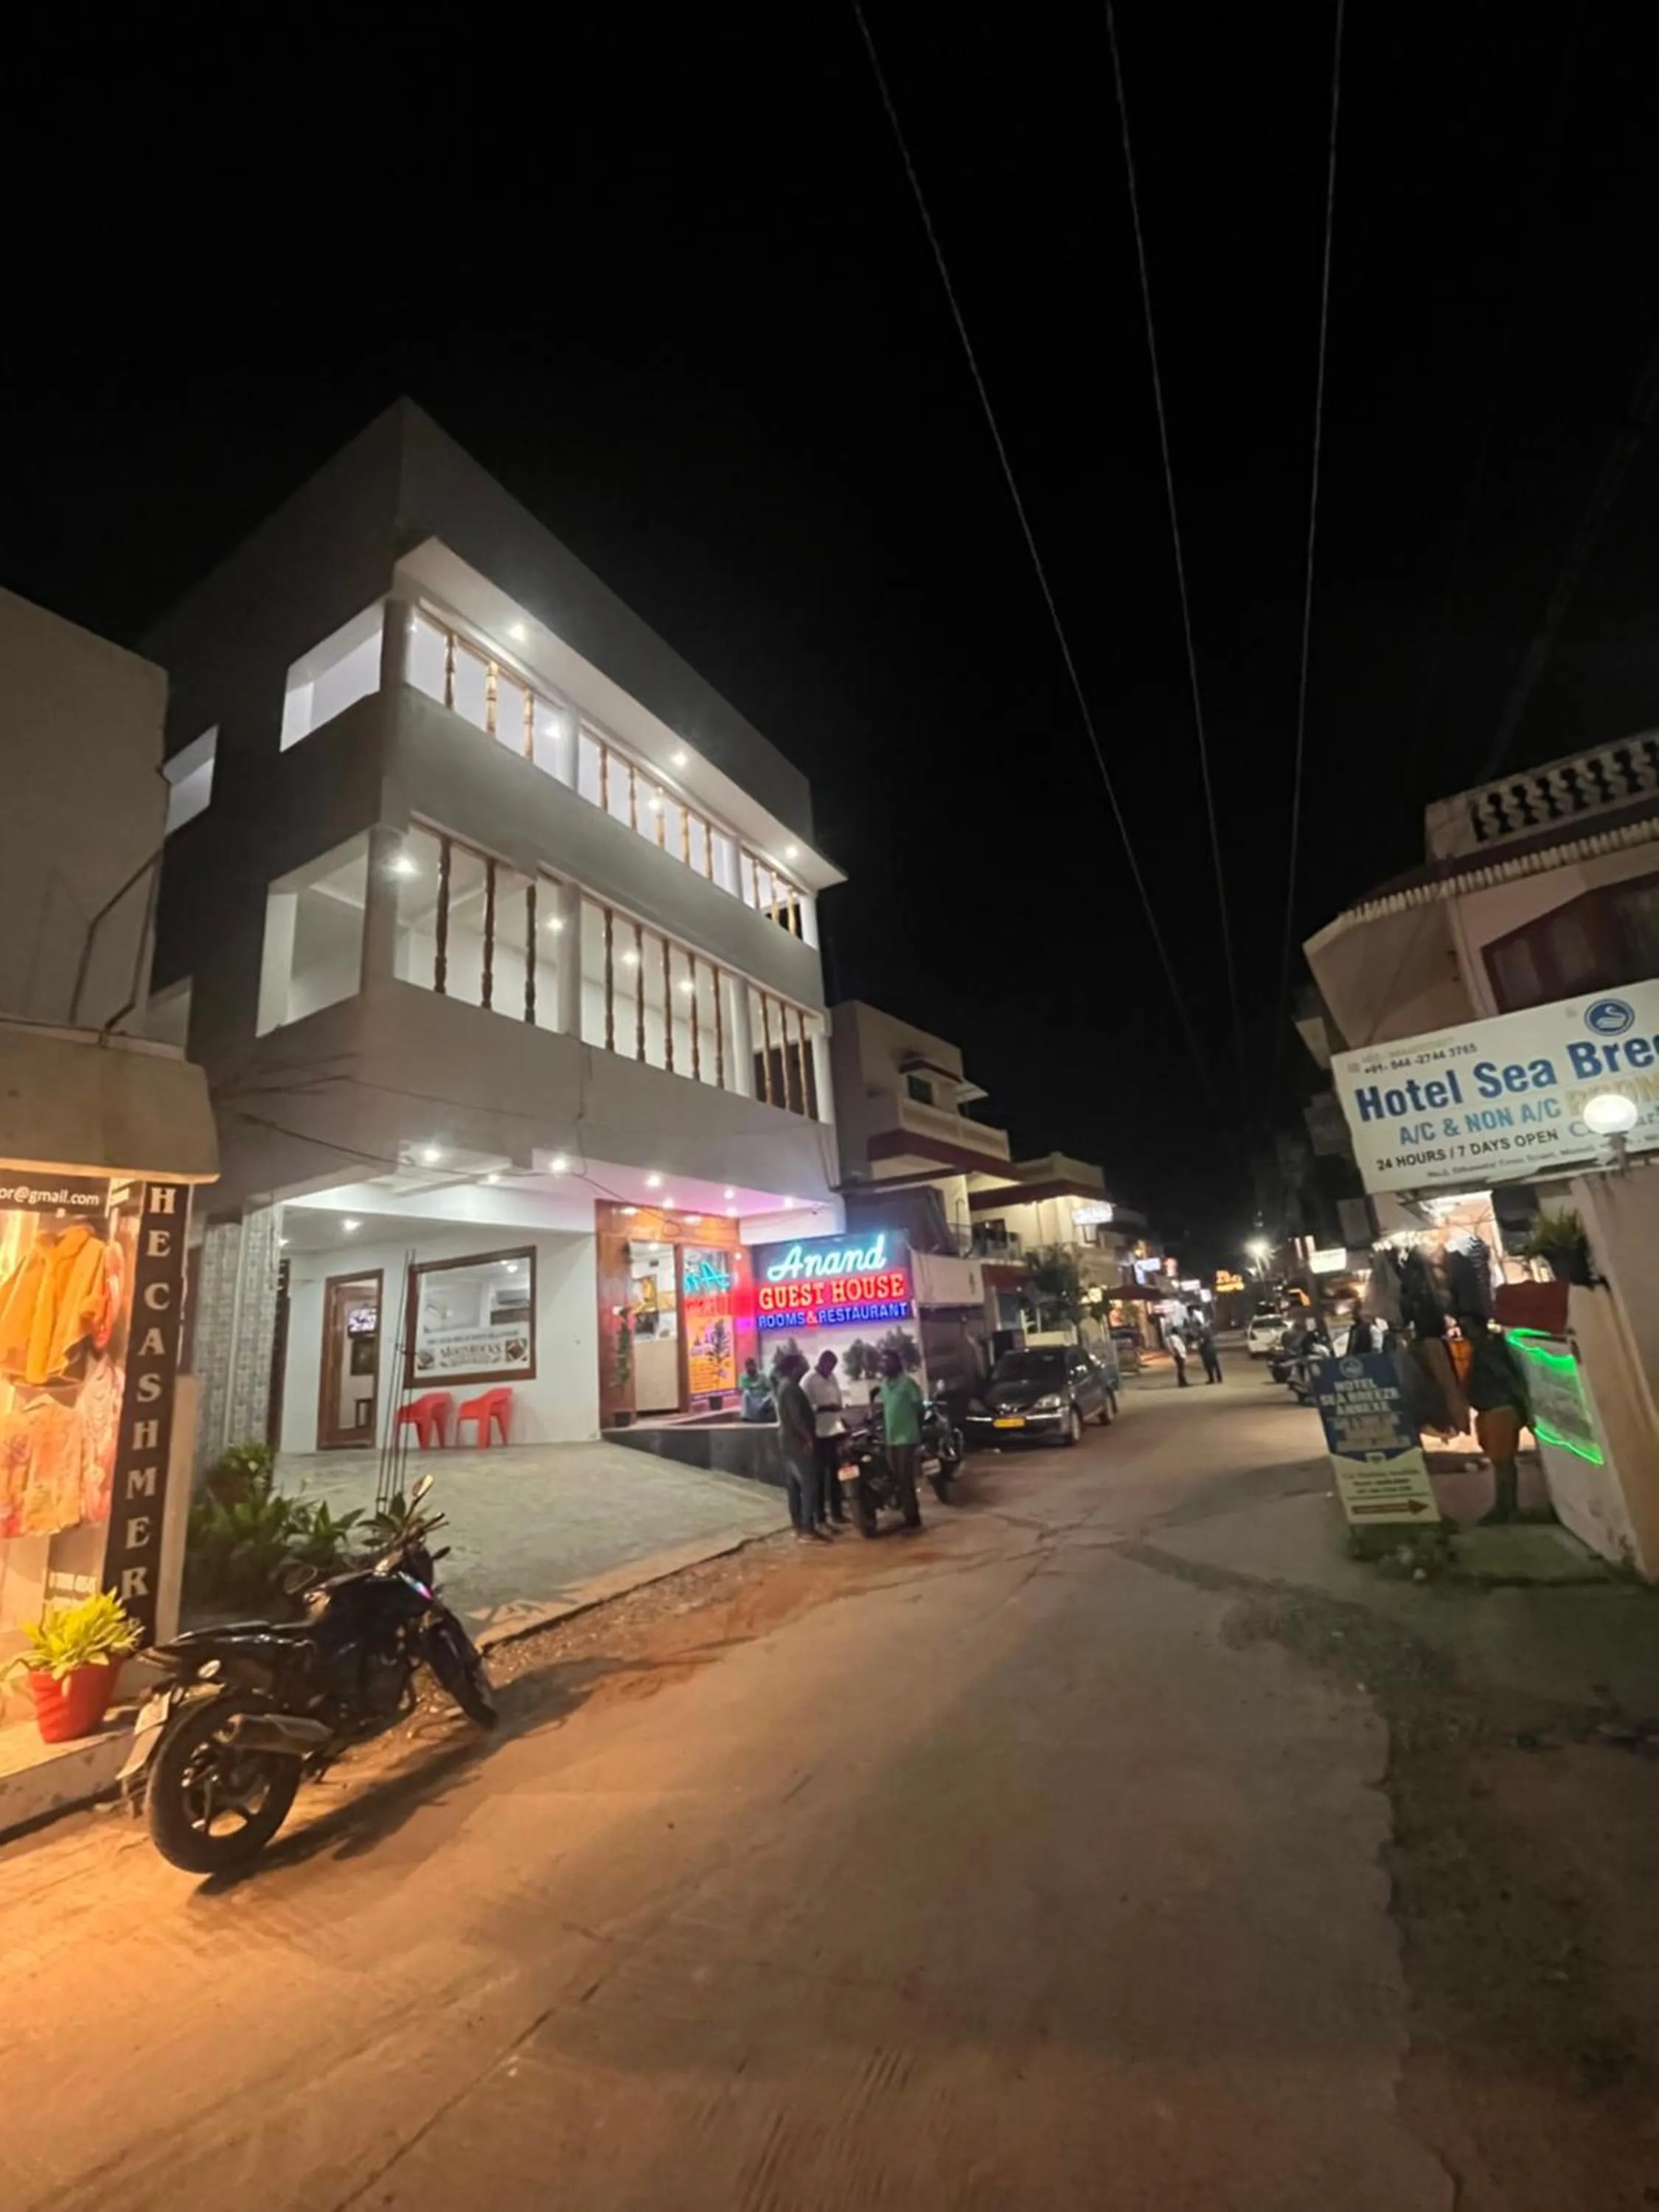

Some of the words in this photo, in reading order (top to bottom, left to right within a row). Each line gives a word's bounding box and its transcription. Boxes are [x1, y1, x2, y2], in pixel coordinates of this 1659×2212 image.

[1355, 1069, 1463, 1121] Hotel
[1474, 1057, 1557, 1099] Sea
[1400, 1121, 1436, 1145] A/C
[1443, 1119, 1461, 1138] &
[1465, 1107, 1514, 1134] NON
[1520, 1098, 1562, 1124] A/C
[1377, 1158, 1393, 1171] 24
[1396, 1149, 1446, 1167] HOURS
[1458, 1145, 1466, 1157] 7
[1470, 1139, 1511, 1155] DAYS
[1518, 1129, 1559, 1147] OPEN
[767, 1233, 887, 1281] Anand
[759, 1283, 824, 1310] GUEST
[832, 1273, 905, 1303] HOUSE
[758, 1311, 805, 1328] ROOMS
[806, 1310, 818, 1325] &
[818, 1301, 908, 1324] RESTAURANT
